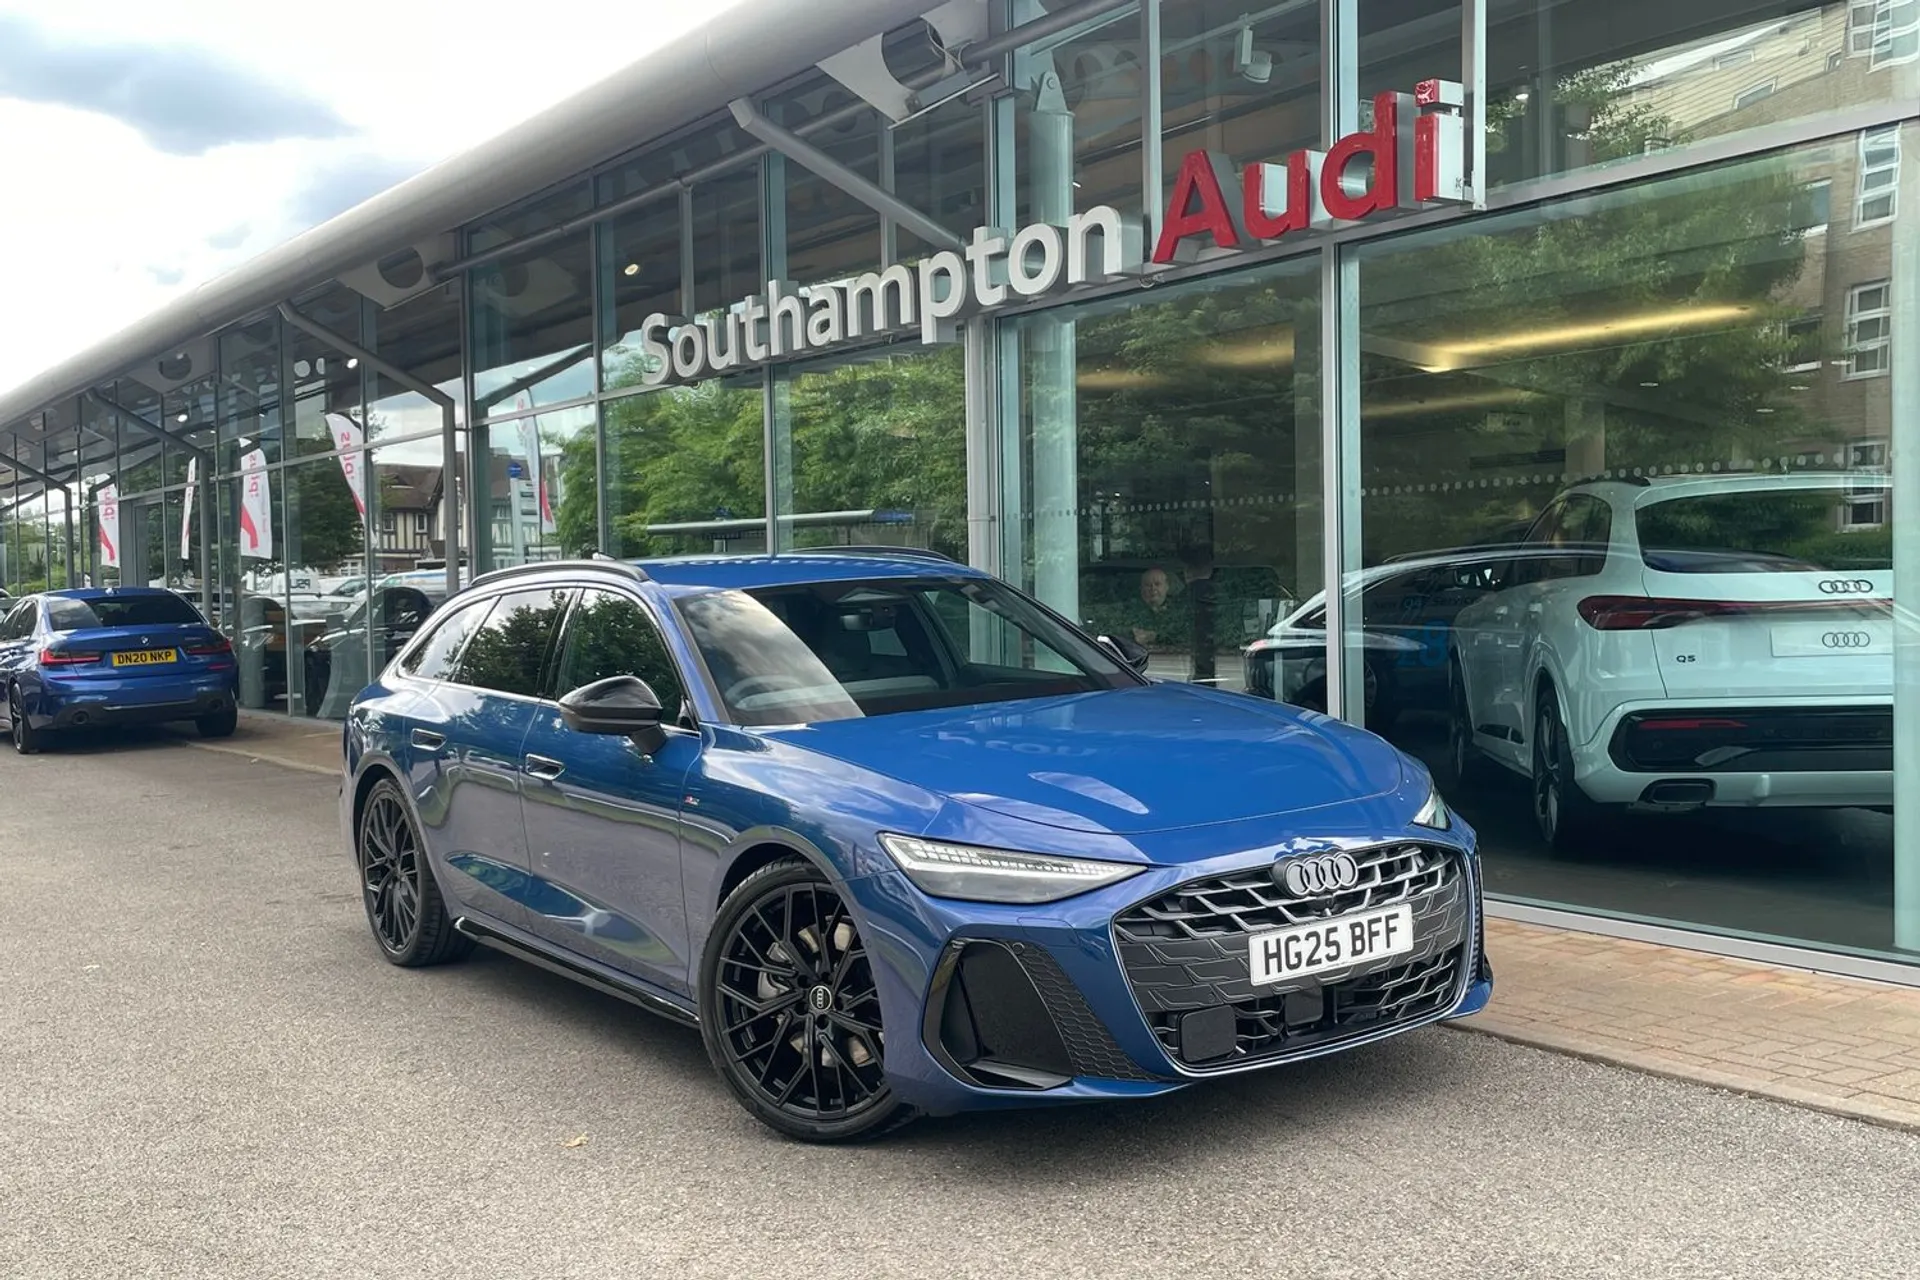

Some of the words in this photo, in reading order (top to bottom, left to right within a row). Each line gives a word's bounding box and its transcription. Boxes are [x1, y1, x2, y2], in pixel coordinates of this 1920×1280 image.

[641, 203, 1124, 386] Southampton
[1152, 78, 1443, 265] Audi
[117, 652, 147, 664] DN20
[149, 651, 172, 663] NKP
[1676, 655, 1696, 663] Q5
[1263, 927, 1341, 975] HG25
[1350, 913, 1399, 957] BFF
